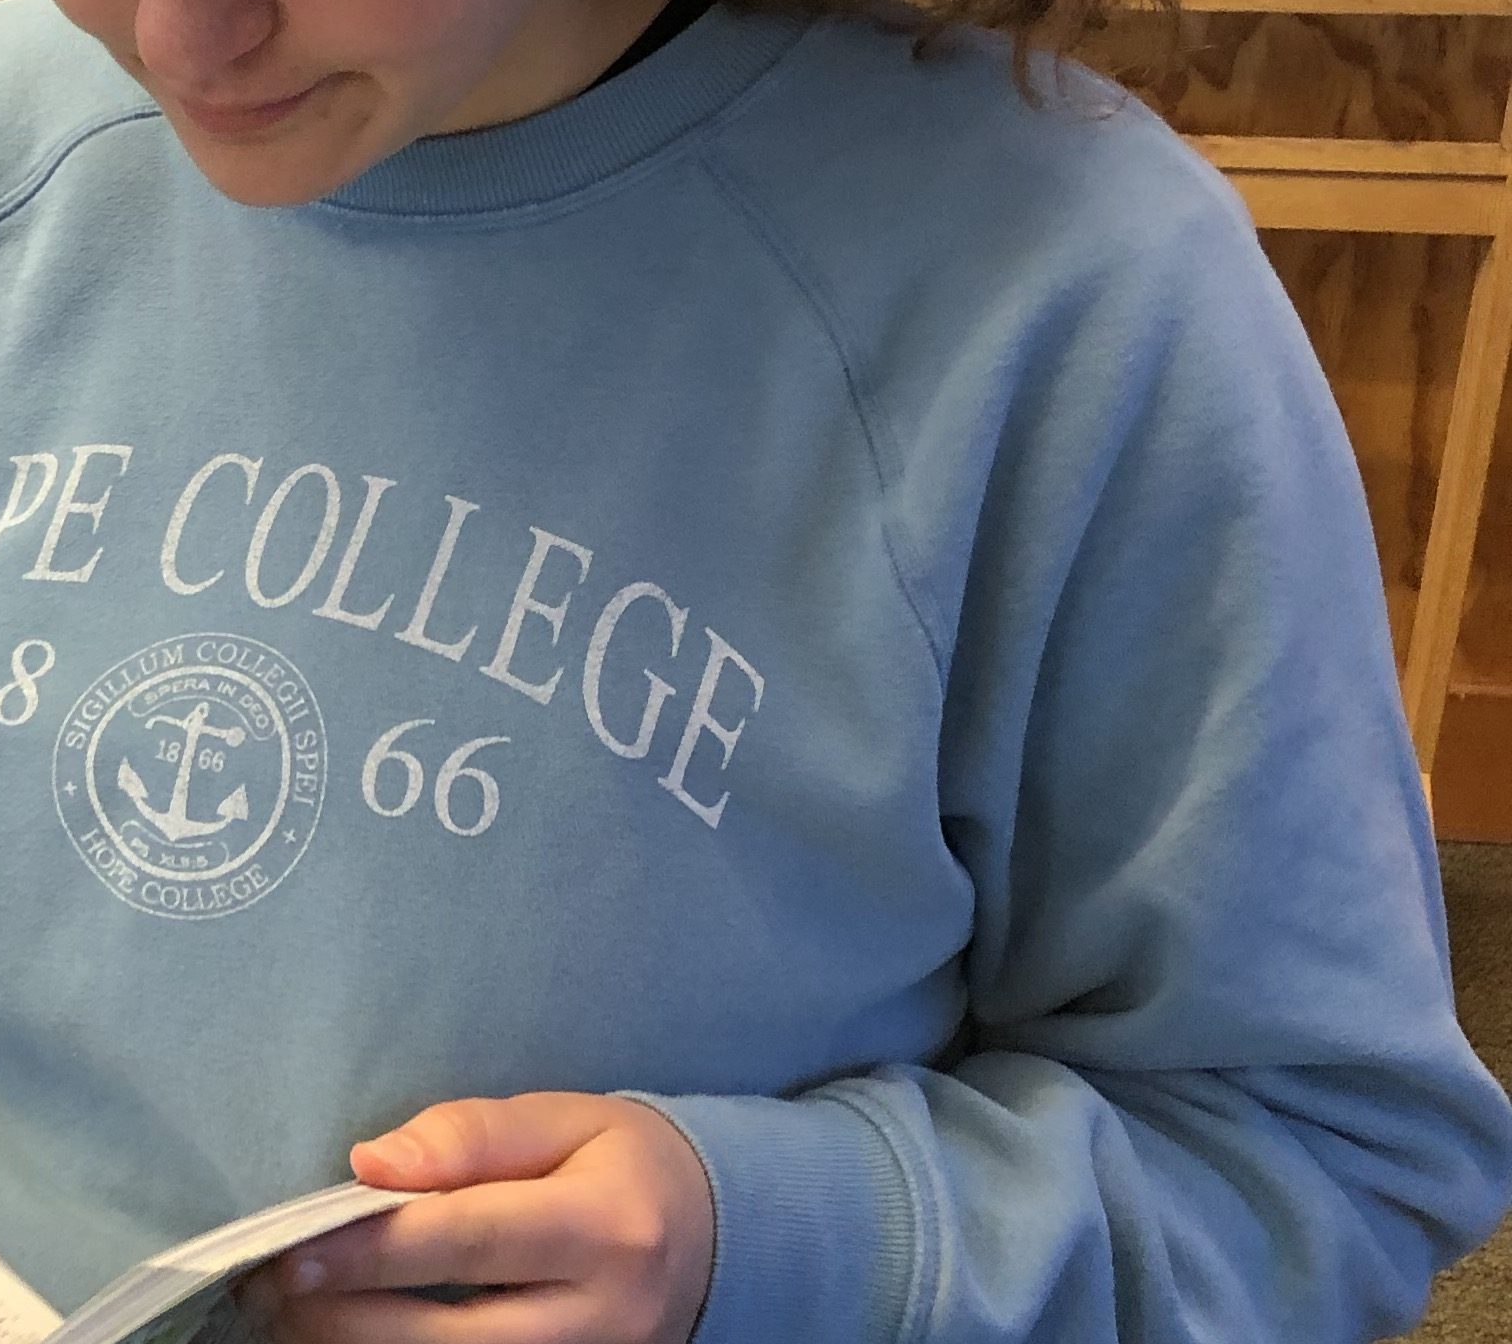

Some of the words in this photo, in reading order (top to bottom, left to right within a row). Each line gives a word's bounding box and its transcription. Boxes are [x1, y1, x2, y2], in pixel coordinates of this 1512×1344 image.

[156, 450, 767, 831] COLLEGE
[64, 642, 186, 751] SIGILLUM
[195, 640, 310, 724] COLLEGII
[292, 729, 319, 808] SPEI
[360, 716, 513, 838] 66
[80, 826, 140, 896] HOPE
[140, 862, 271, 912] COLLEGE
